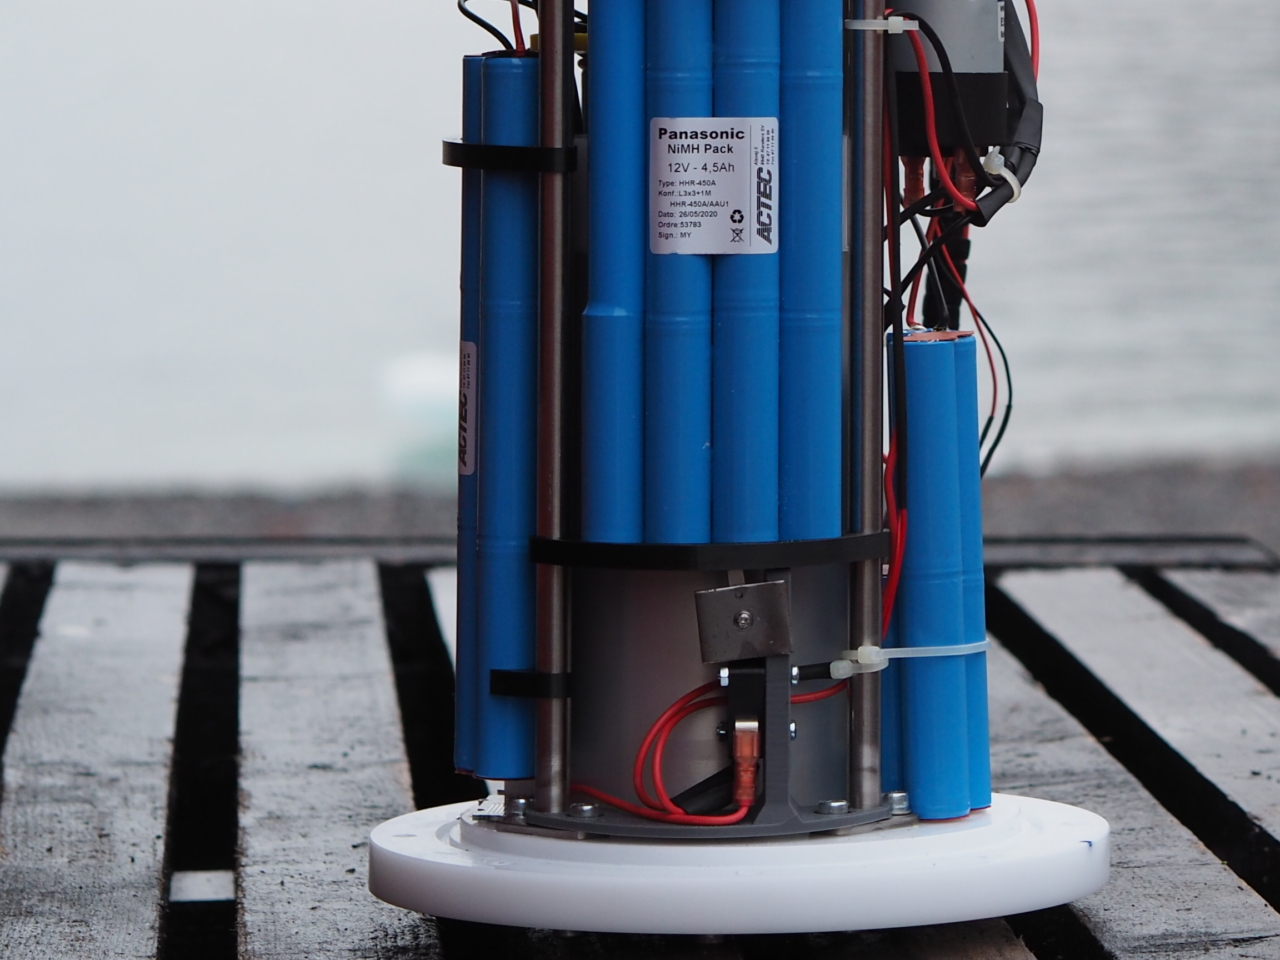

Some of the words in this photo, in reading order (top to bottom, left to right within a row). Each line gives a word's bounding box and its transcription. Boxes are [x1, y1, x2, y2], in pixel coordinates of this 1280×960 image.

[658, 128, 745, 140] Panasonic
[667, 144, 700, 154] NiMH
[704, 144, 734, 154] Pack
[668, 162, 690, 173] 12V
[701, 162, 735, 174] 4,5Ah
[658, 180, 677, 188] Type:
[670, 200, 729, 208] HHR-450A/AAU1
[756, 167, 773, 245] ACTEC
[658, 232, 678, 240] Sign.:
